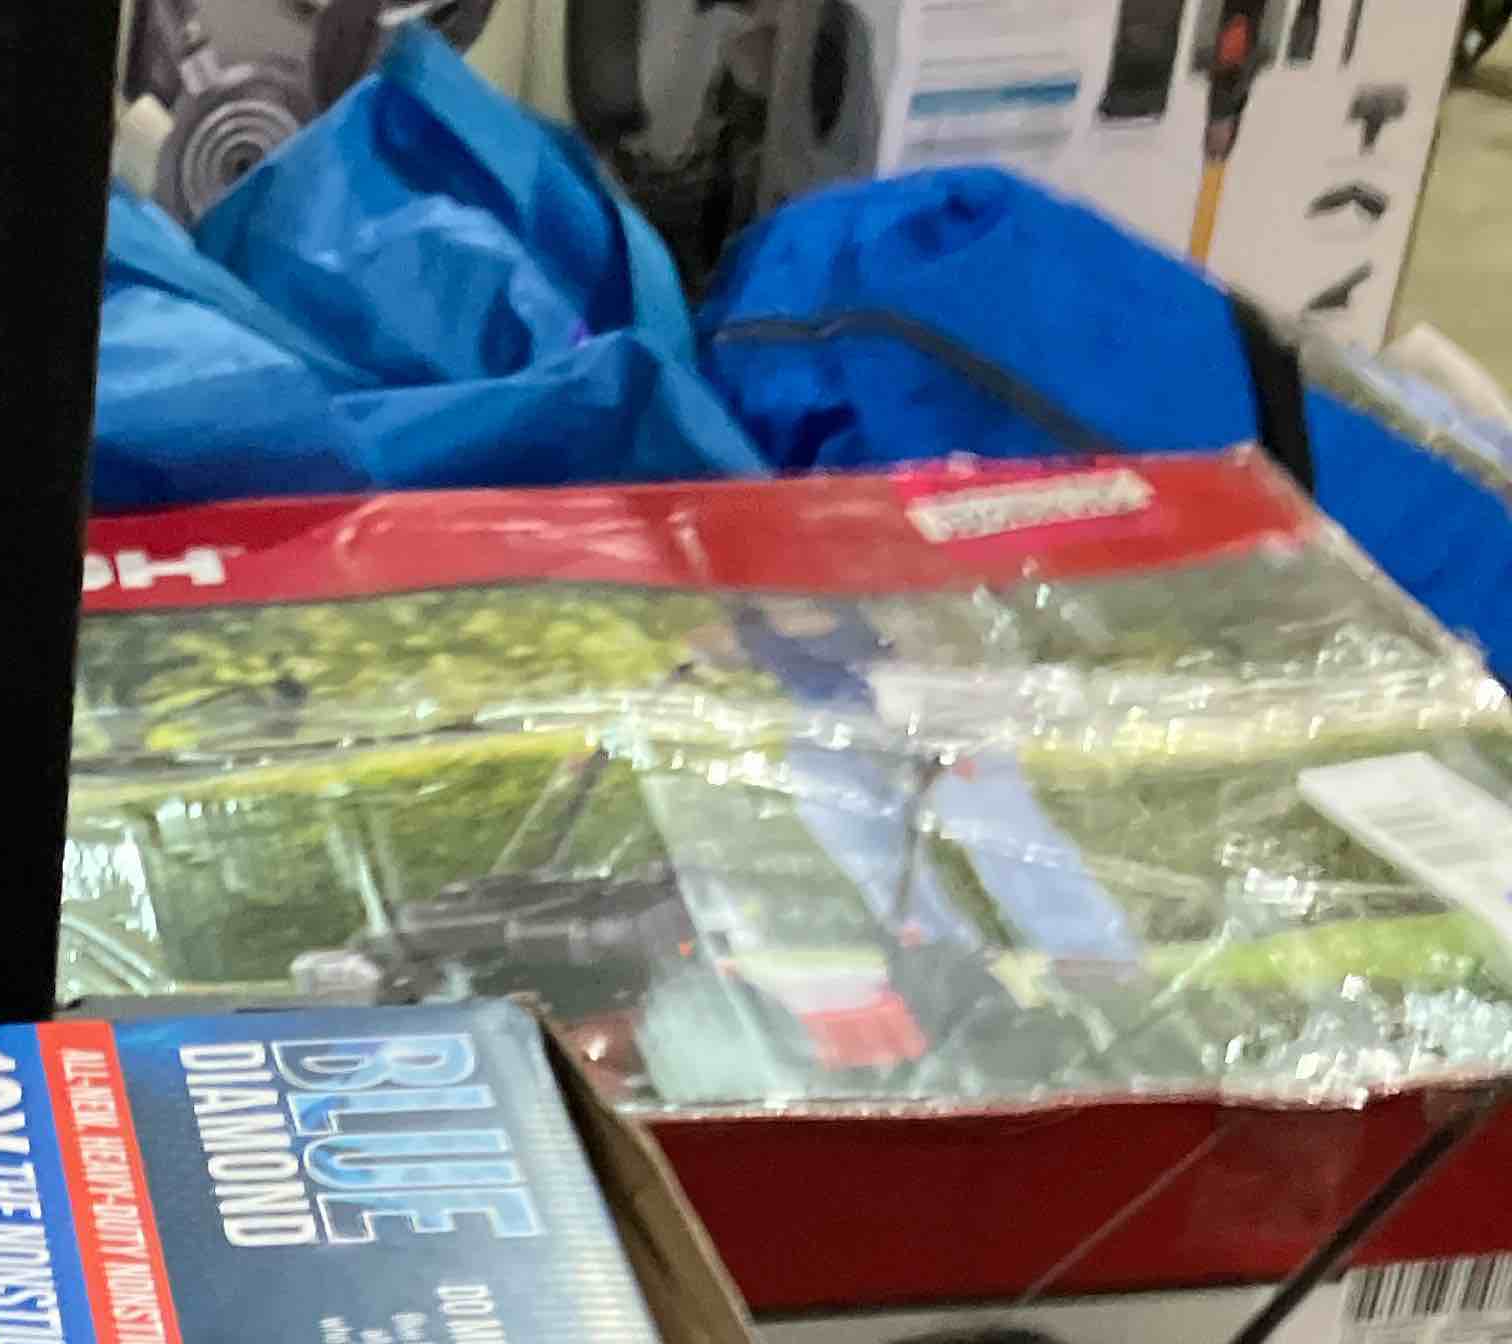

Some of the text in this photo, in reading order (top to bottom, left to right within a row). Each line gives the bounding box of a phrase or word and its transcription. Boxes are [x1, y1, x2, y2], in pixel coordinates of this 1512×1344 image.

[80, 1135, 154, 1259] HEAVY-DUTY
[180, 1041, 316, 1247] DIAMOND
[270, 1033, 548, 1246] BLUE
[433, 1285, 494, 1314] DO
